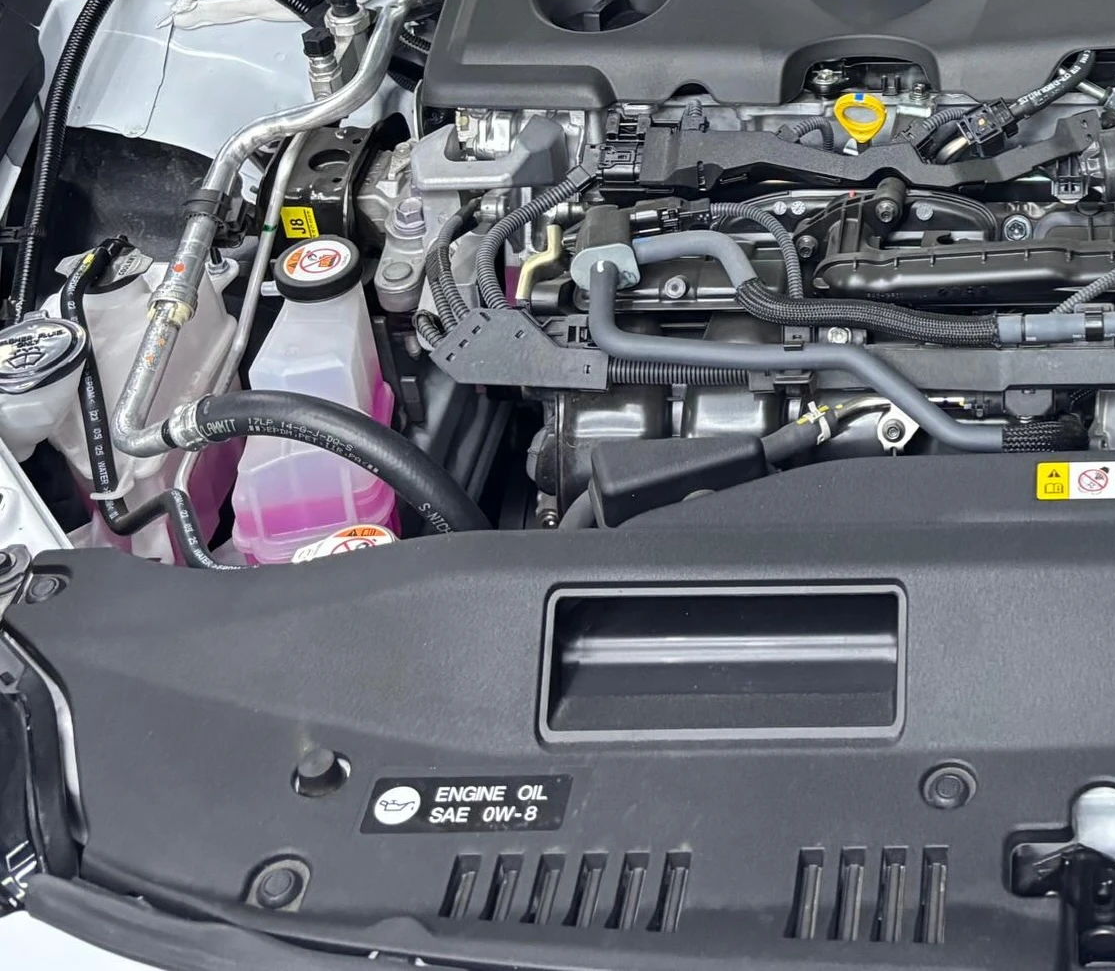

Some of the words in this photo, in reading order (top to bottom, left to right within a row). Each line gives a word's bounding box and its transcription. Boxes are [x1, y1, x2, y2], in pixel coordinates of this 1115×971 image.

[290, 218, 307, 235] J8
[434, 786, 507, 803] ENGINE
[517, 784, 549, 801] OIL
[428, 806, 471, 824] SAE
[482, 805, 538, 823] 0W-8
